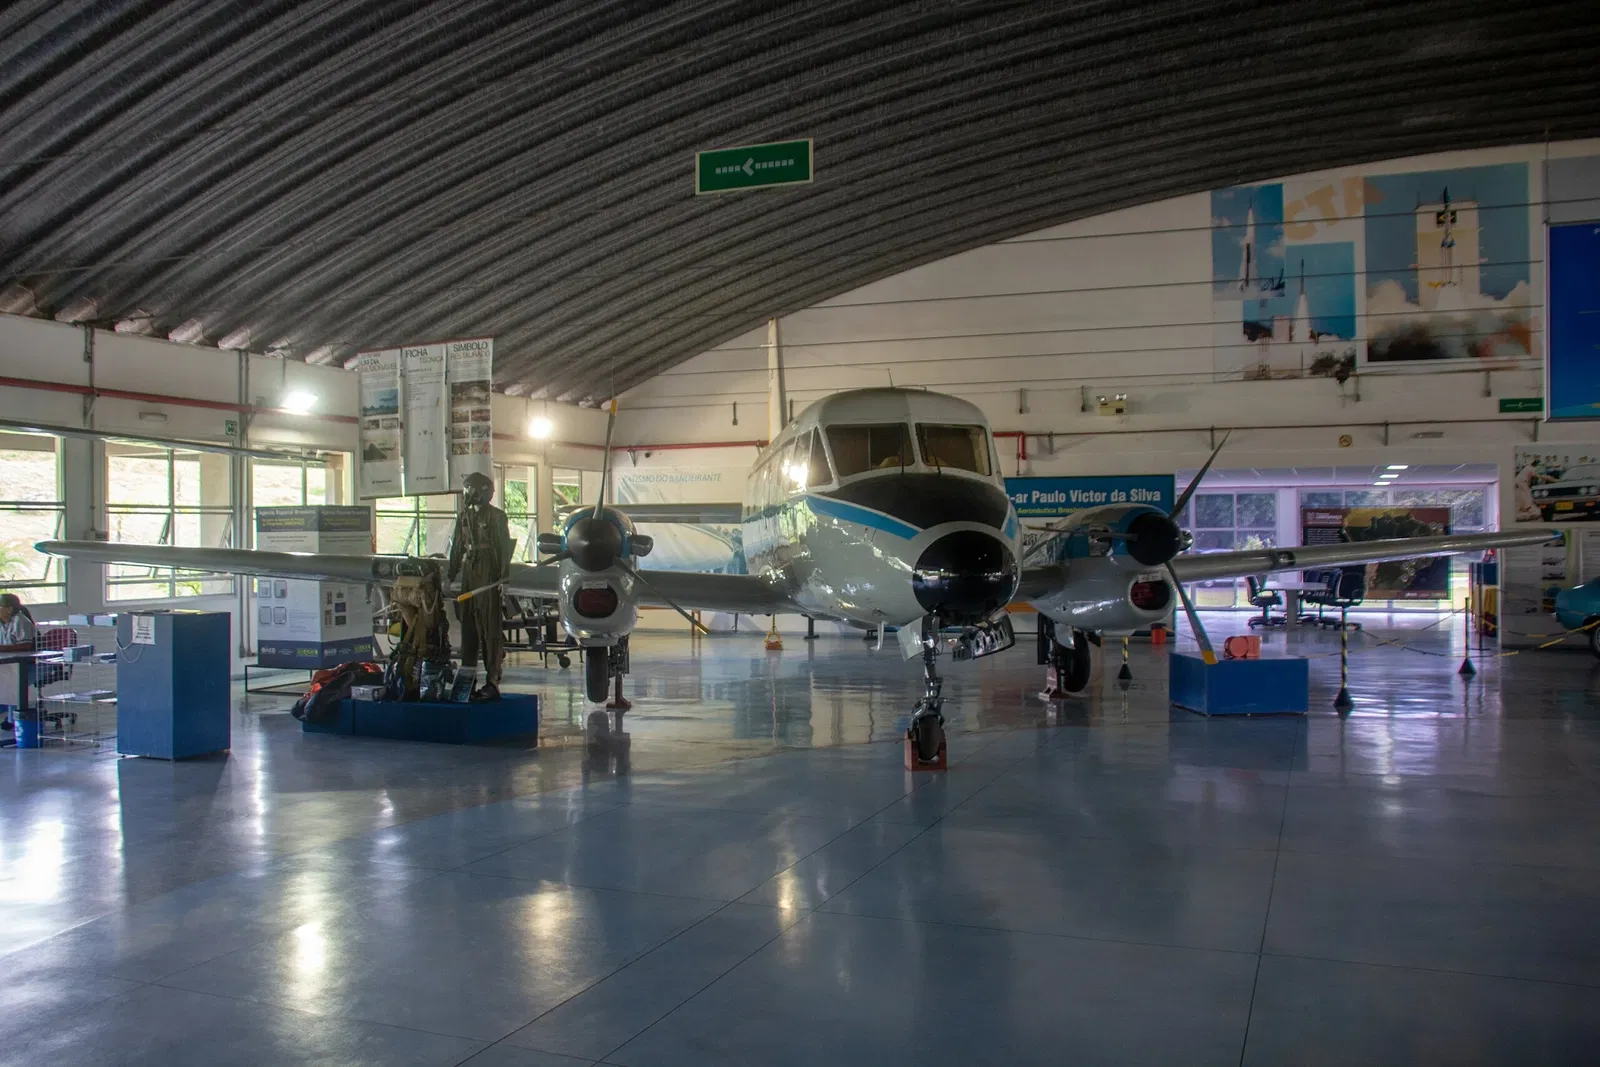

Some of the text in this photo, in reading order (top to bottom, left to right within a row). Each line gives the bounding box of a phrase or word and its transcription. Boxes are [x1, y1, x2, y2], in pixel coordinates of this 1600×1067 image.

[404, 348, 428, 358] FICHA
[1032, 490, 1066, 503] Paulo
[1069, 489, 1107, 502] Victor
[1111, 489, 1126, 502] da
[1130, 488, 1161, 502] Silva
